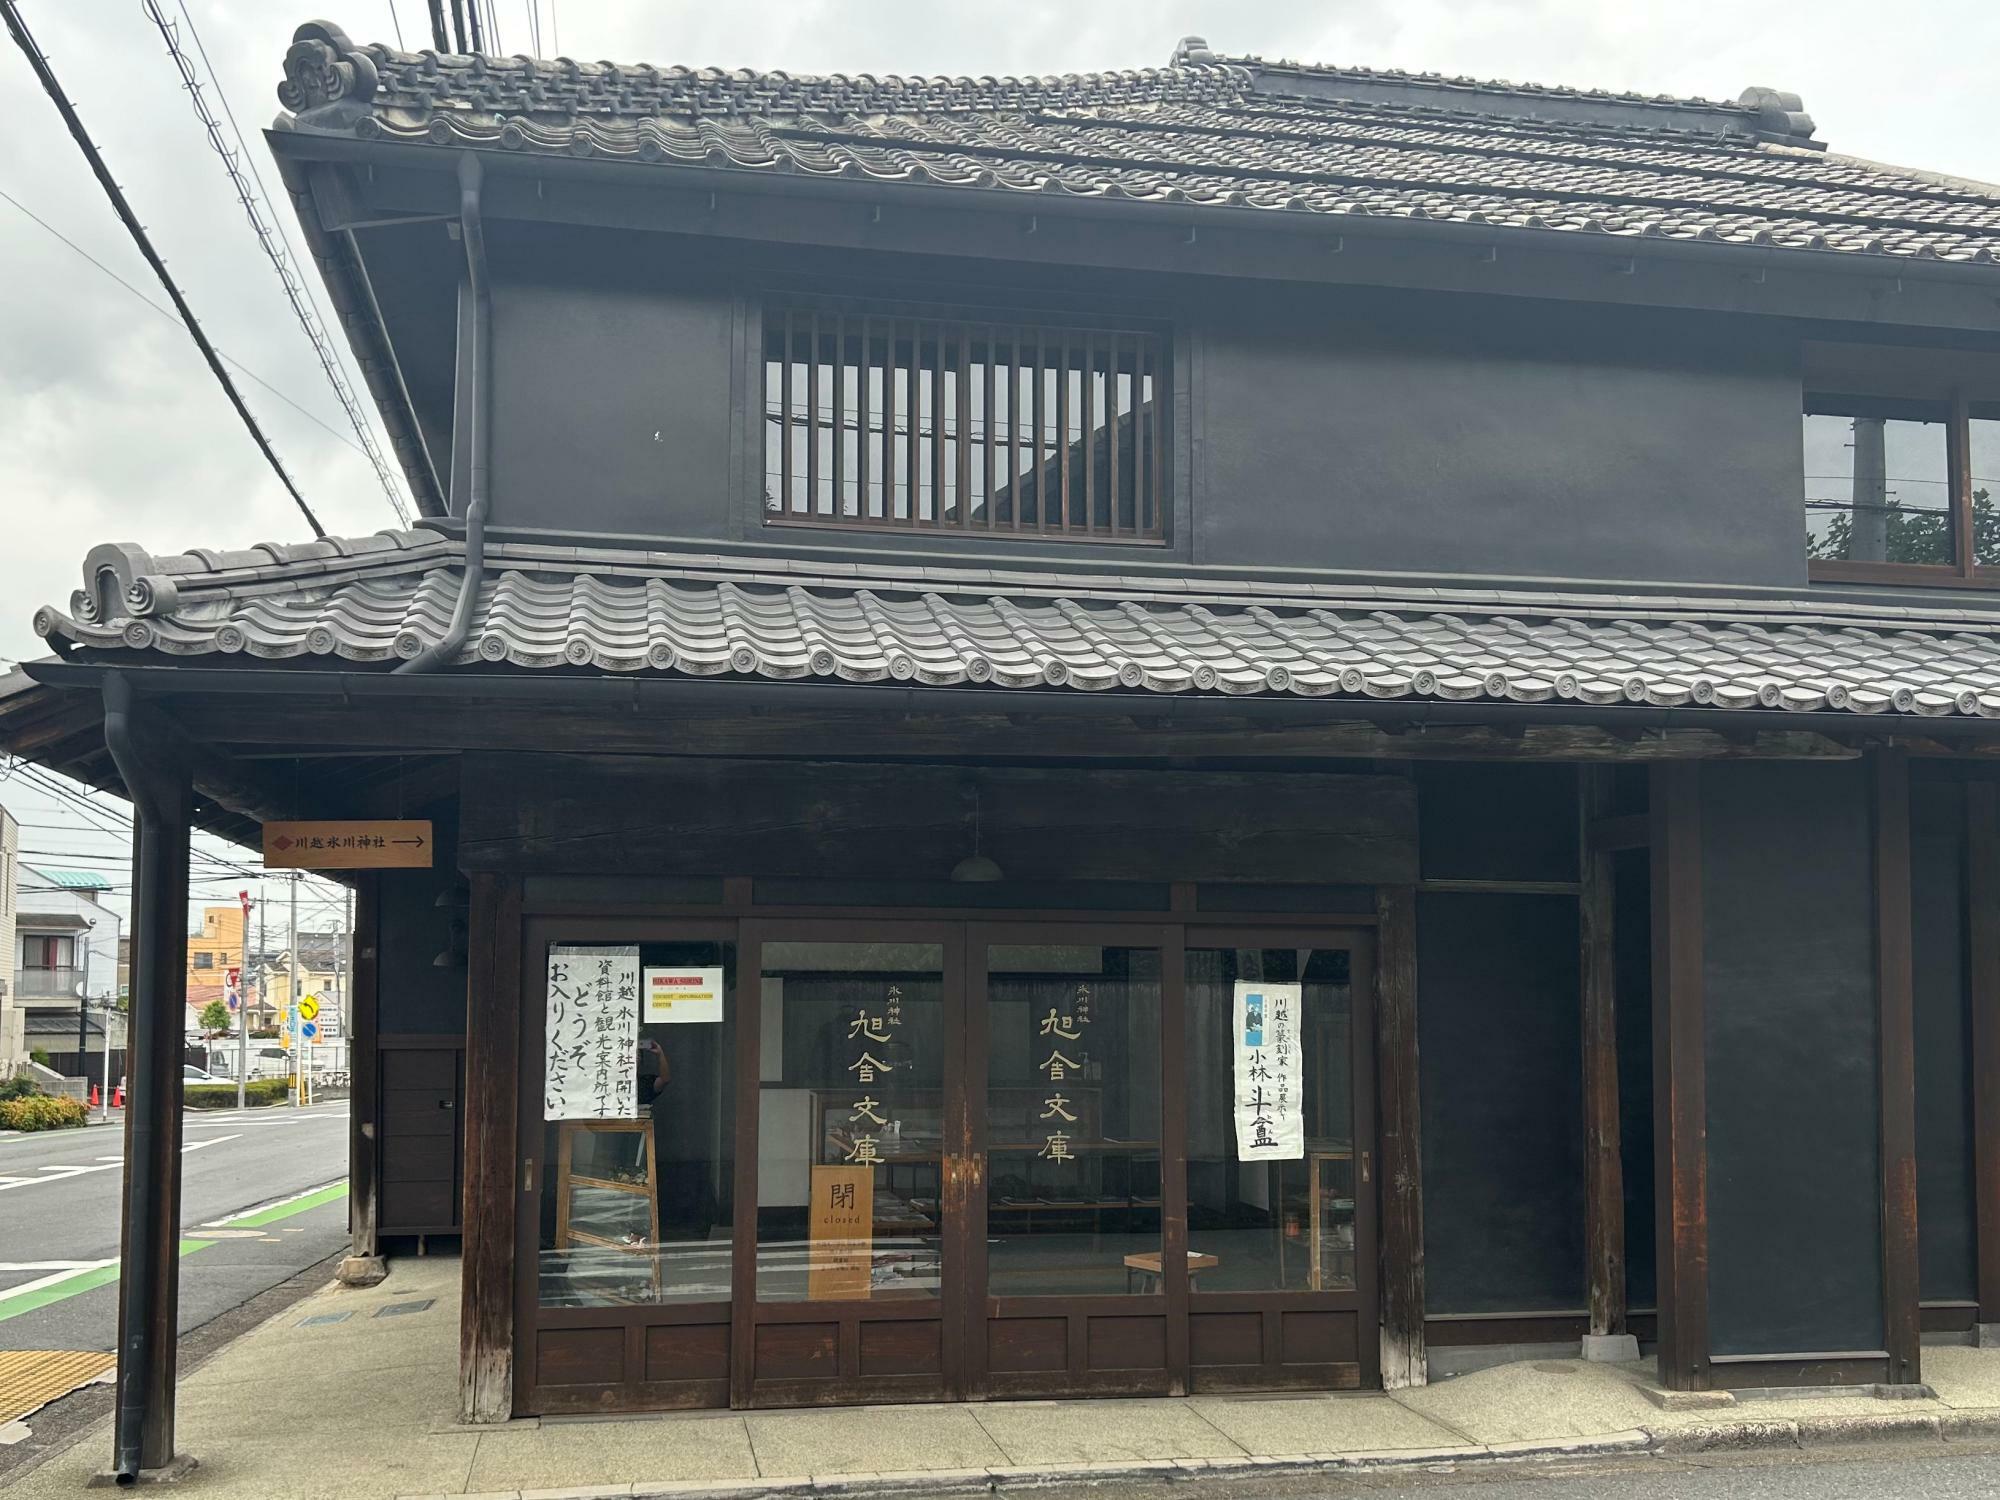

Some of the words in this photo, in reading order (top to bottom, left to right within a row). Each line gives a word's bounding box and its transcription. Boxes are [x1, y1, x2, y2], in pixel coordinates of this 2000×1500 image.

[295, 835, 386, 849] 川越氷川神社
[593, 959, 616, 1118] 資料館と観光案内所です
[615, 971, 635, 1116] 川越氷川神社で開いた
[830, 1183, 855, 1209] 閉
[824, 1216, 860, 1224] closed
